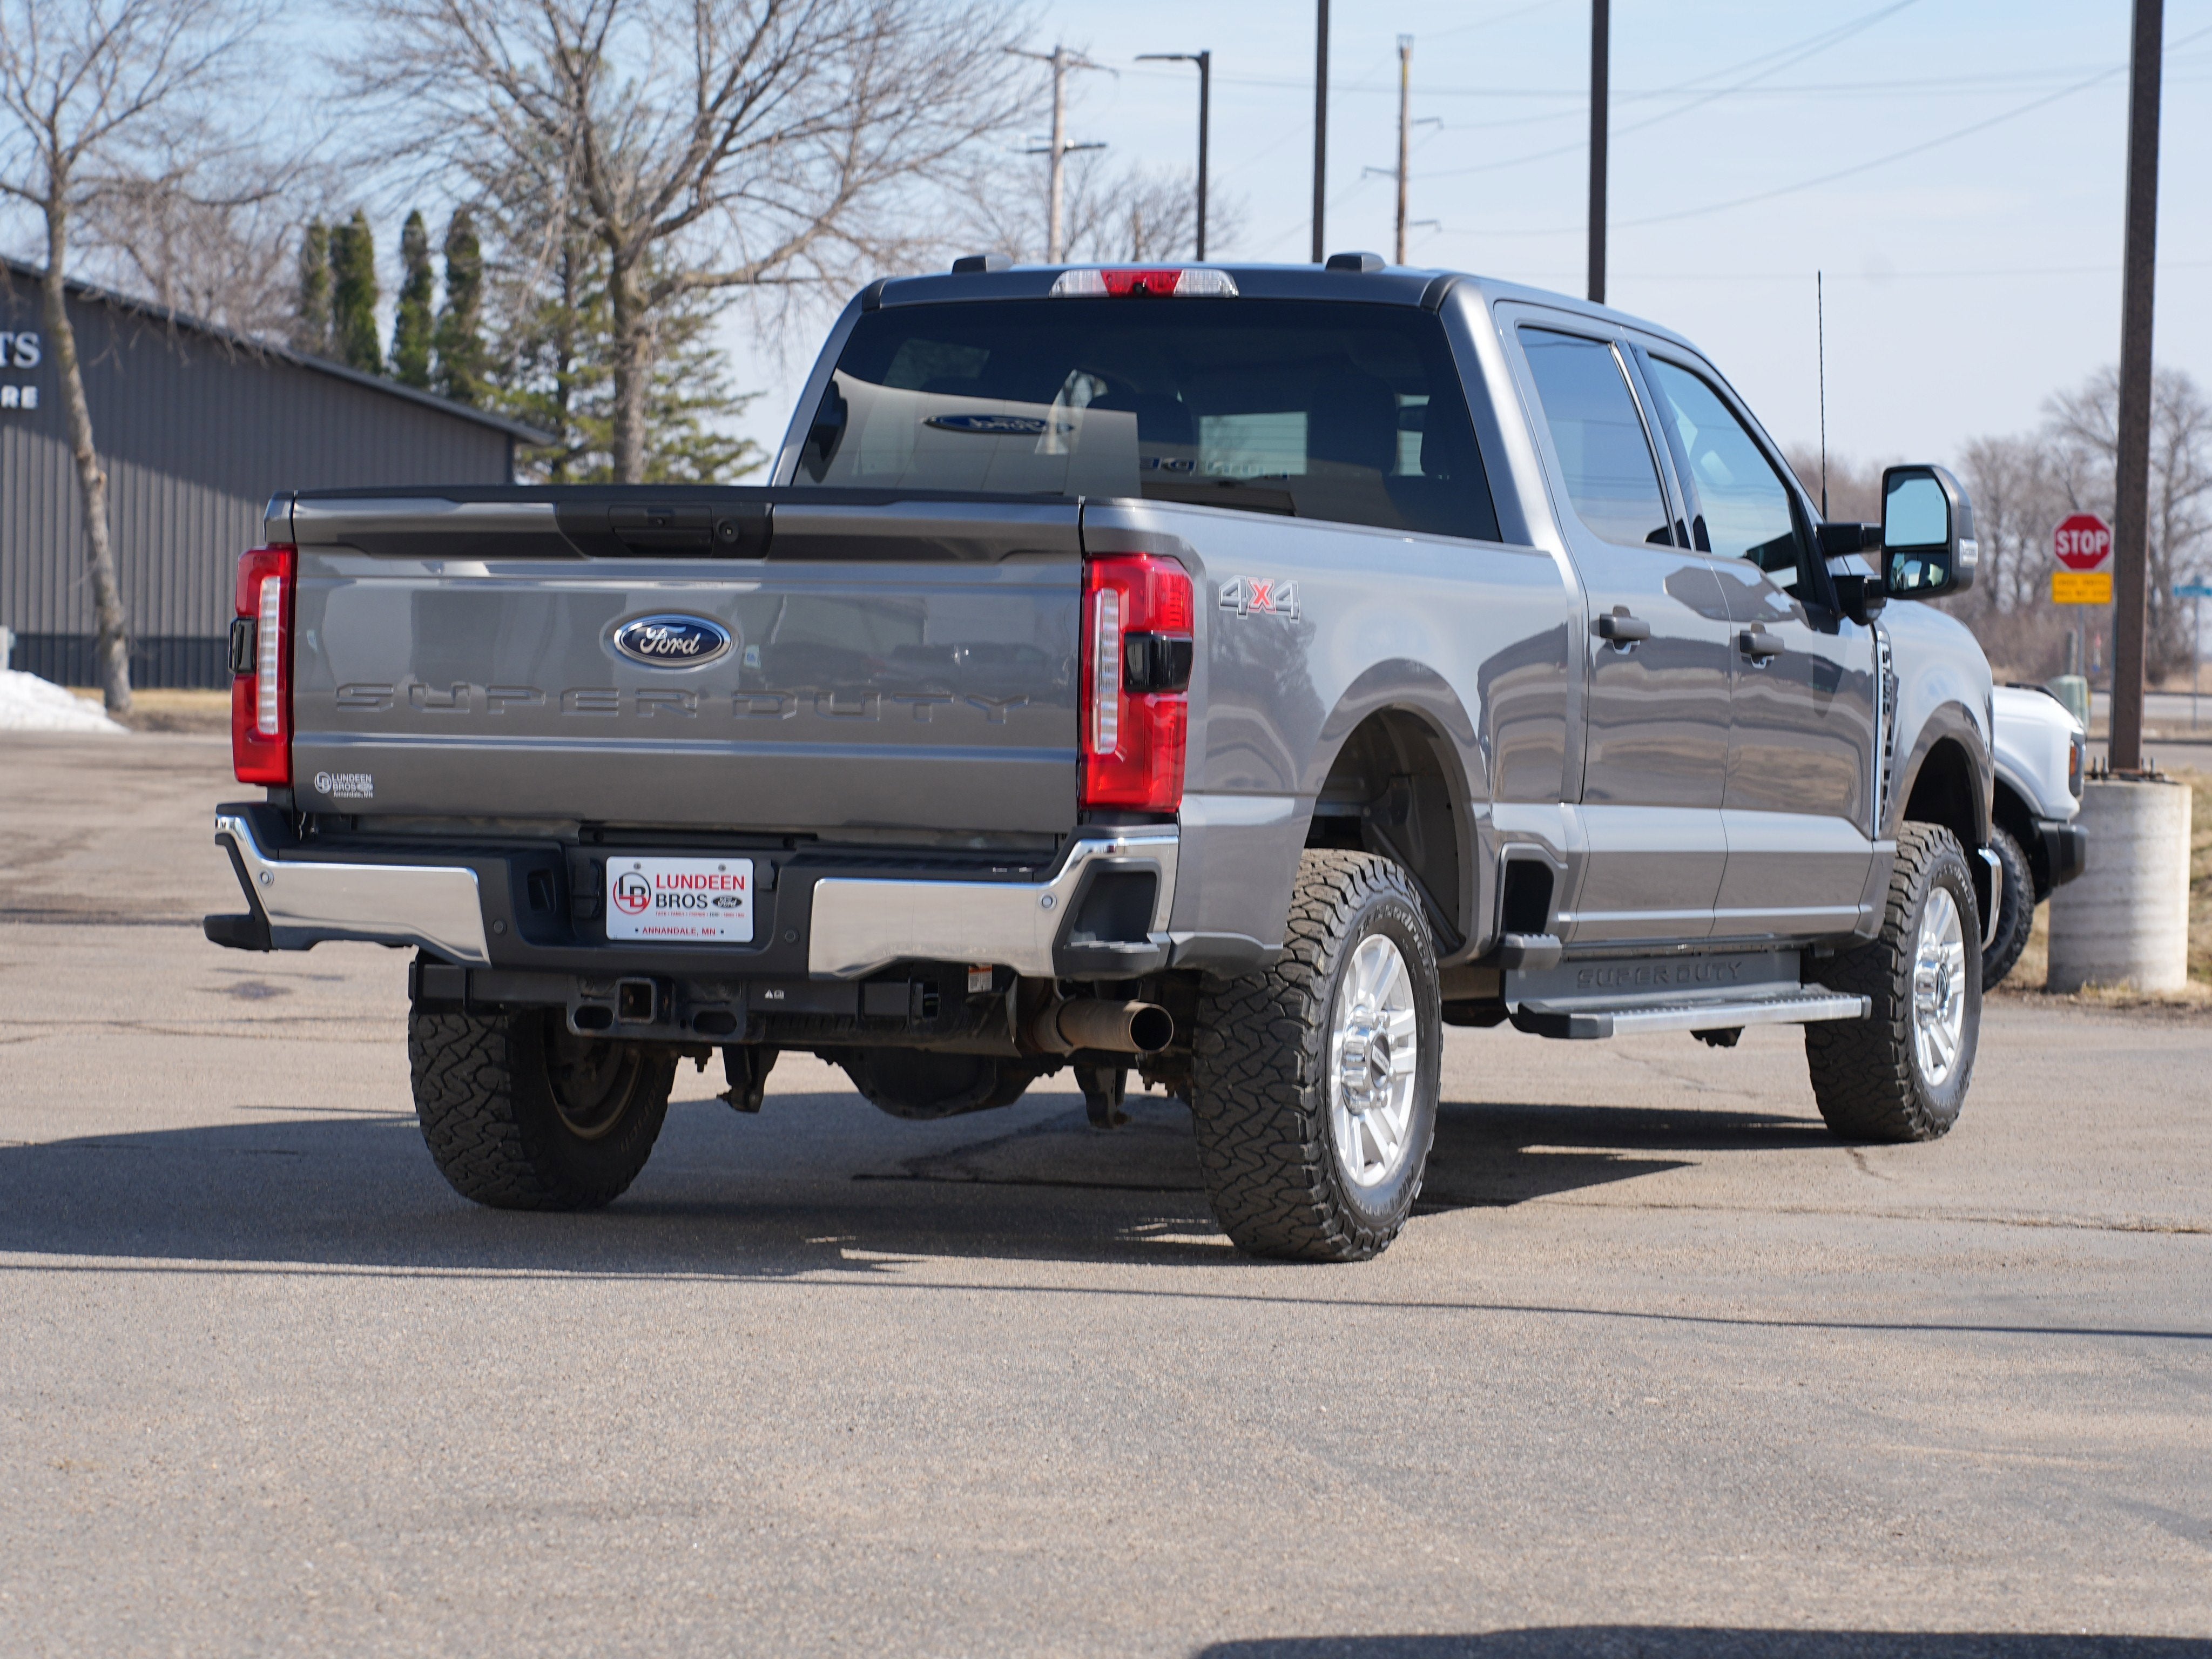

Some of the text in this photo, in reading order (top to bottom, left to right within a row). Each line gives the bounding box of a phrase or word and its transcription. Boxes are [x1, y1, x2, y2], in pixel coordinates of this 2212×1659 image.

[2056, 529, 2109, 555] STOP
[640, 624, 702, 655] Ford
[336, 682, 1029, 724] SUPER DUTY
[332, 773, 372, 784] LUNDEEN
[332, 783, 356, 792] BROS
[656, 873, 745, 891] LUNDEEN
[656, 893, 708, 909] BROS
[643, 927, 699, 936] ANNANDALE,
[1577, 961, 1742, 989] SUPER DUTY
